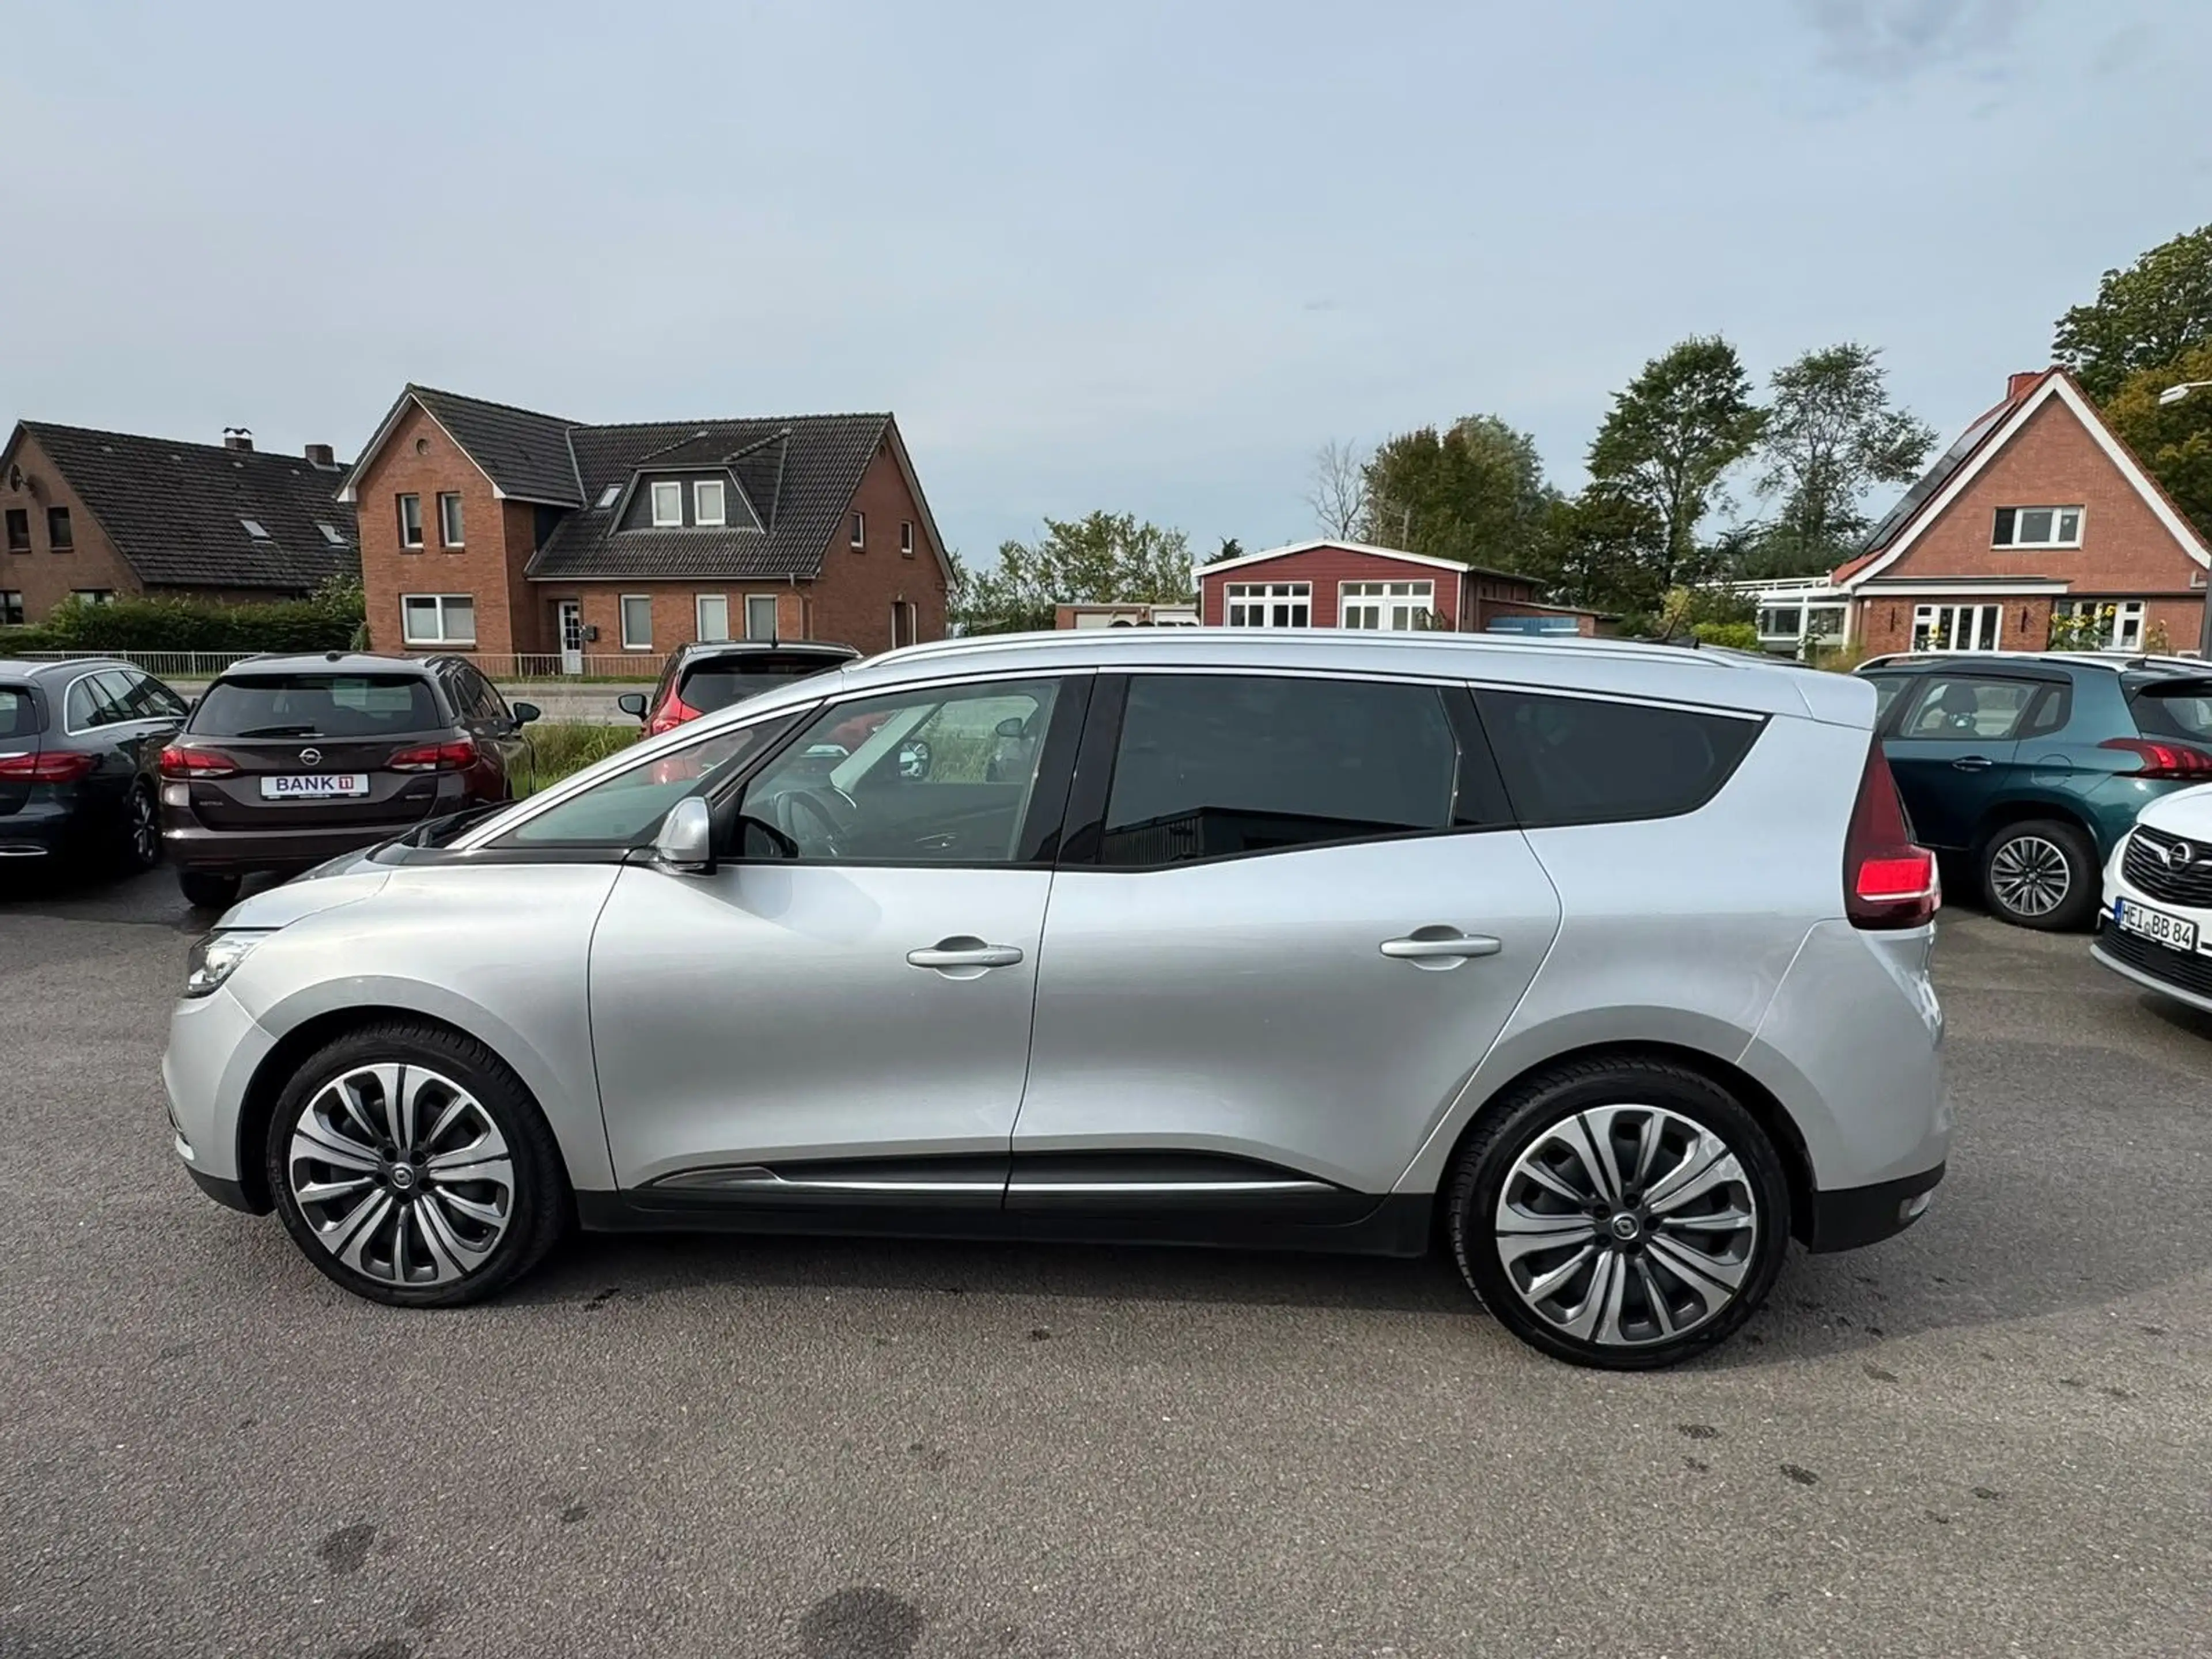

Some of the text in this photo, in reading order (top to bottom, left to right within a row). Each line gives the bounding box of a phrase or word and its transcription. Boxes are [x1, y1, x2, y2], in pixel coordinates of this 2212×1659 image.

[276, 777, 335, 791] BANK
[2122, 904, 2191, 945] HEI BB 84
